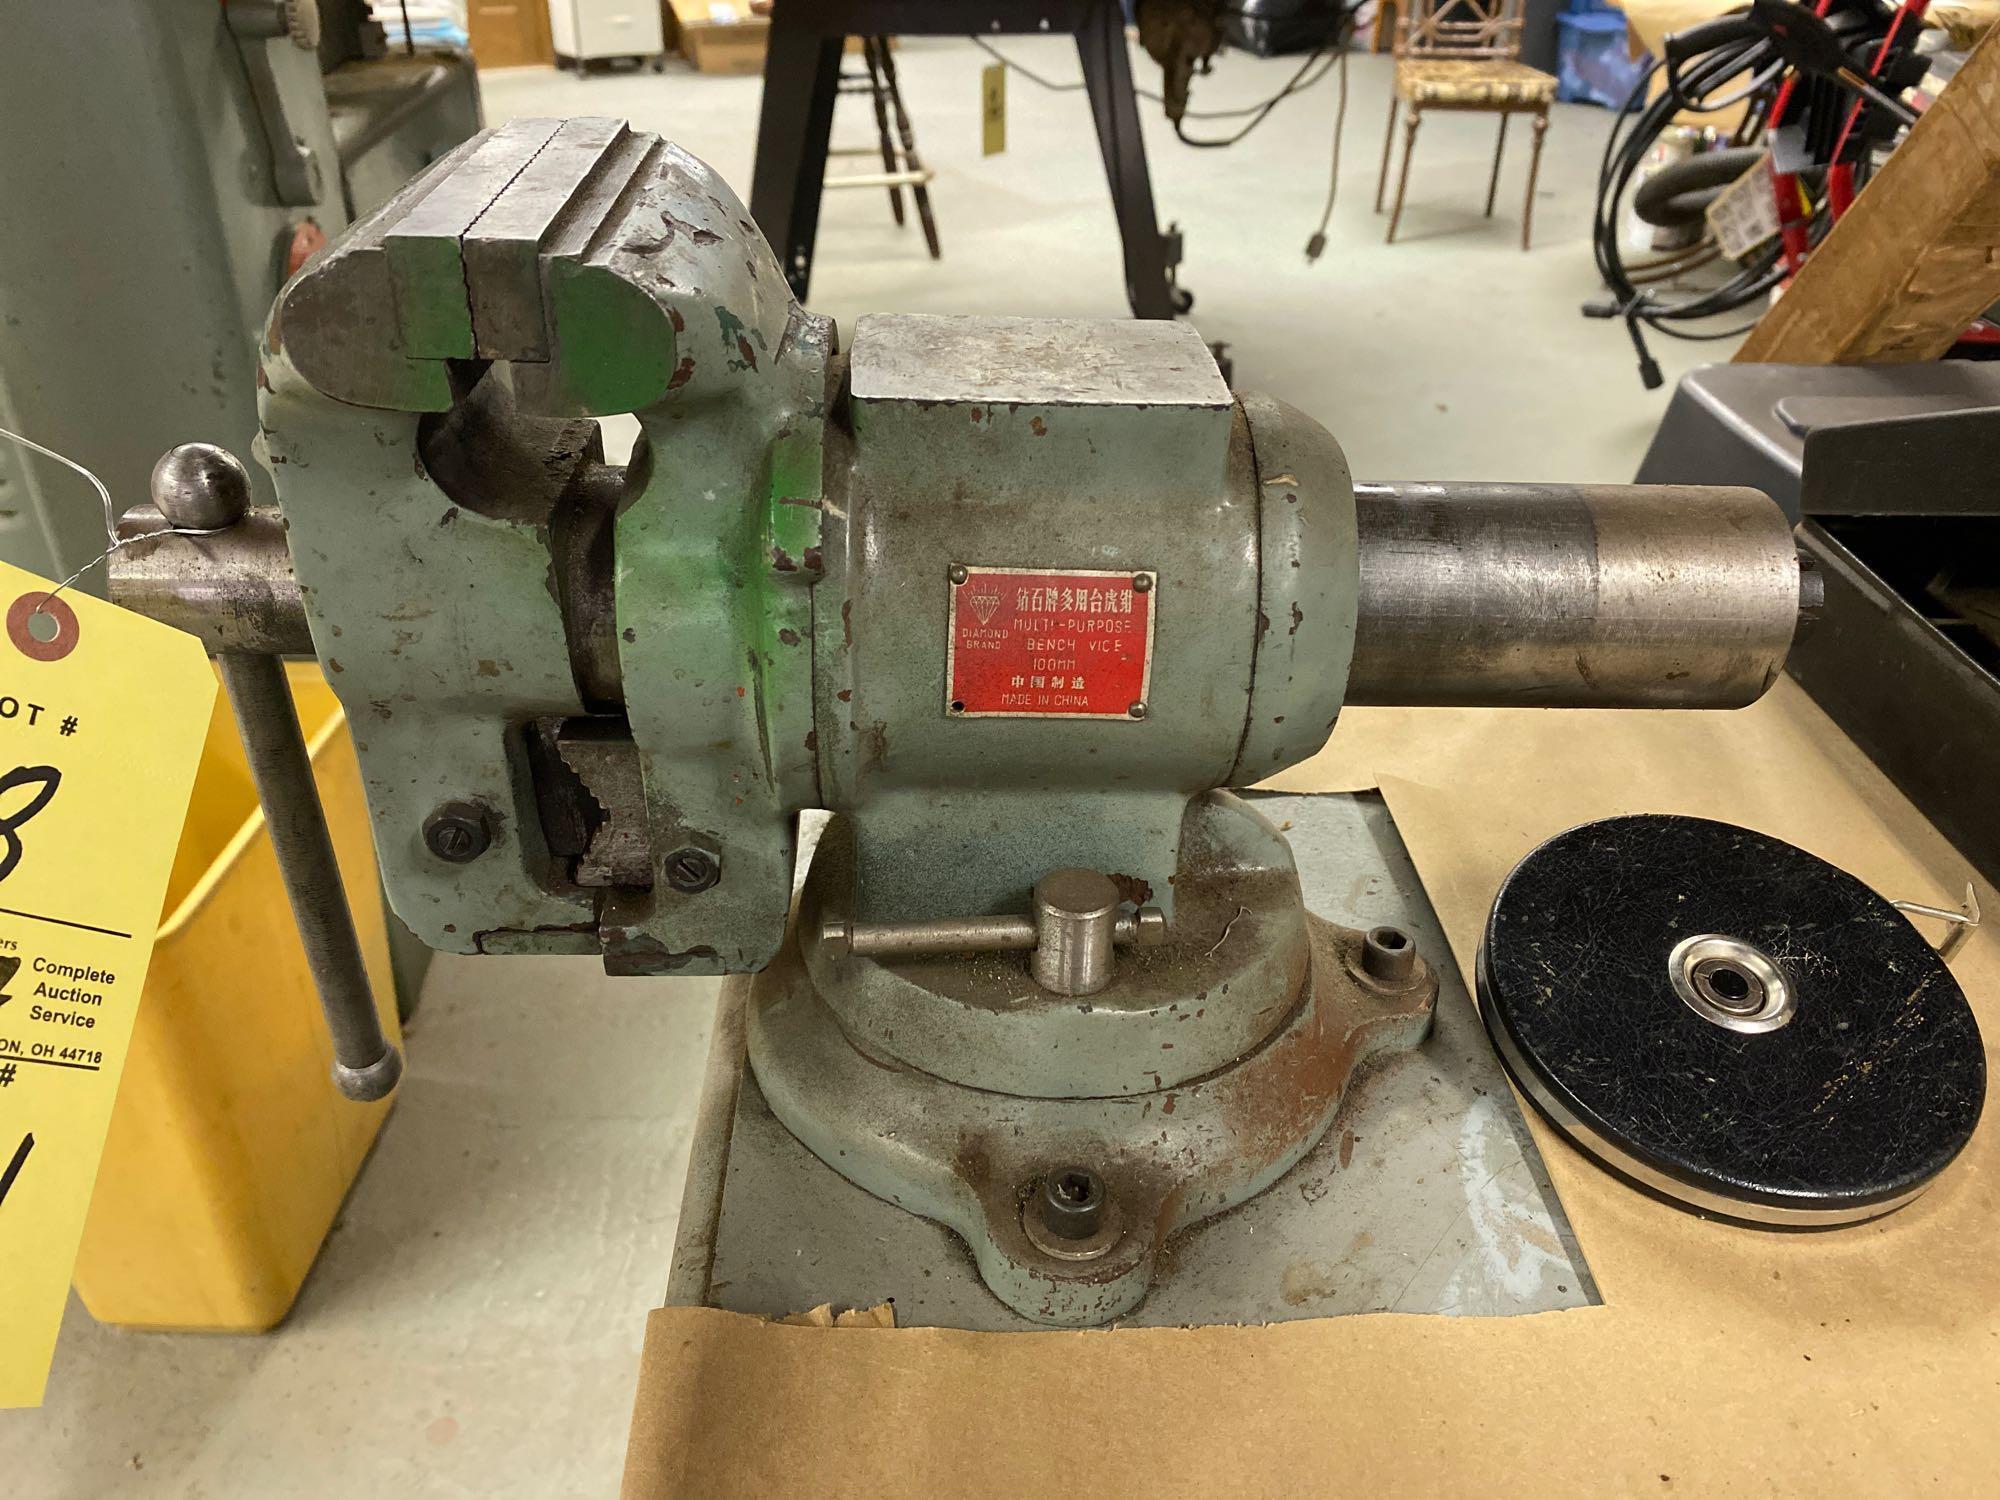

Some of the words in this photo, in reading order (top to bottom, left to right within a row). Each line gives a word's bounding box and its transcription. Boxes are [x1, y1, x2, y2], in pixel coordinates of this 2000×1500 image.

[1014, 618, 1132, 633] MULTI-PURPOSE
[962, 628, 1009, 639] DIAMOND
[966, 640, 1001, 650] BRAND
[1027, 638, 1076, 651] BENCH
[1089, 640, 1123, 653] VICE
[1033, 658, 1076, 671] 100MM
[1011, 675, 1086, 690] 中国制造
[1002, 694, 1031, 705] MADE
[1038, 694, 1049, 705] IN
[1054, 695, 1089, 706] CHINA
[33, 957, 115, 985] Complete
[33, 982, 103, 1006] Auction
[30, 1005, 96, 1028] Service
[31, 1043, 55, 1058] OH
[60, 1047, 103, 1064] 44718
